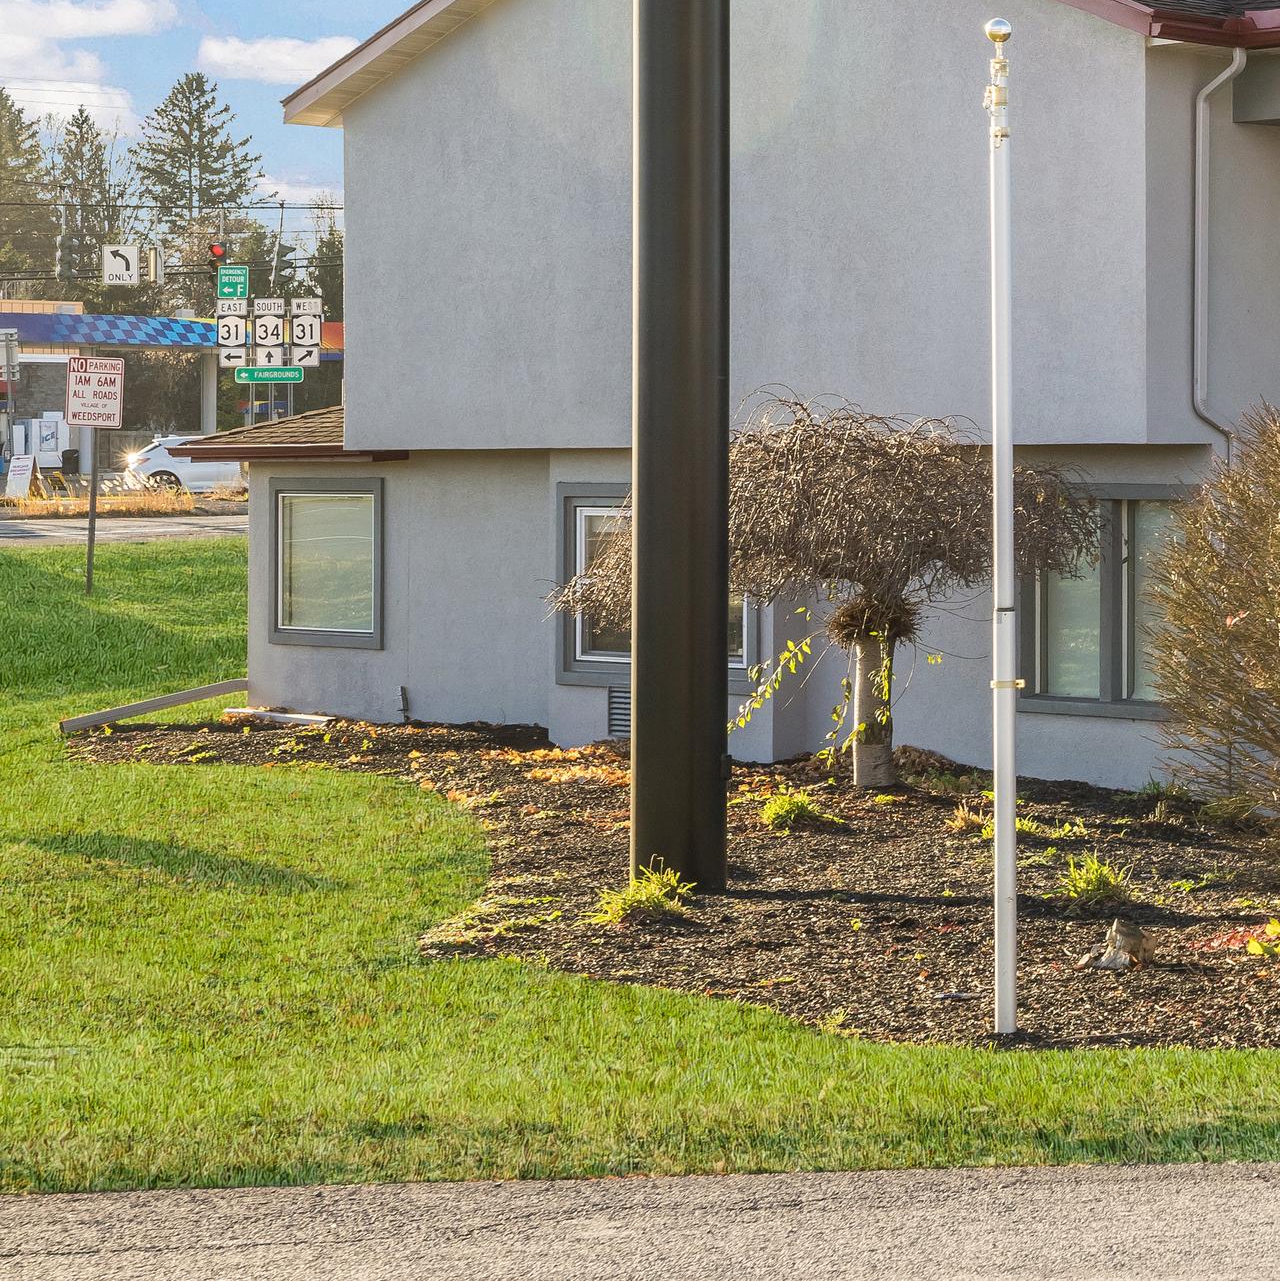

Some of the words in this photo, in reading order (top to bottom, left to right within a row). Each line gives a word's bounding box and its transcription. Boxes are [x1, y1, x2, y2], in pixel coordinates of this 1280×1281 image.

[108, 273, 134, 281] ONLY
[222, 275, 245, 283] DETOUR
[237, 284, 244, 296] F
[221, 303, 243, 312] EAST
[256, 302, 282, 311] SOUTH
[220, 323, 239, 340] 31
[258, 323, 280, 340] 34
[295, 323, 313, 340] 31
[70, 358, 86, 372] NO
[89, 361, 121, 372] PARKING
[74, 375, 91, 387] 1AM
[97, 376, 116, 387] 6AM
[72, 389, 86, 399] ALL
[93, 390, 118, 400] ROADS
[72, 411, 116, 423] WEEDSPORT
[42, 431, 55, 444] ICE
